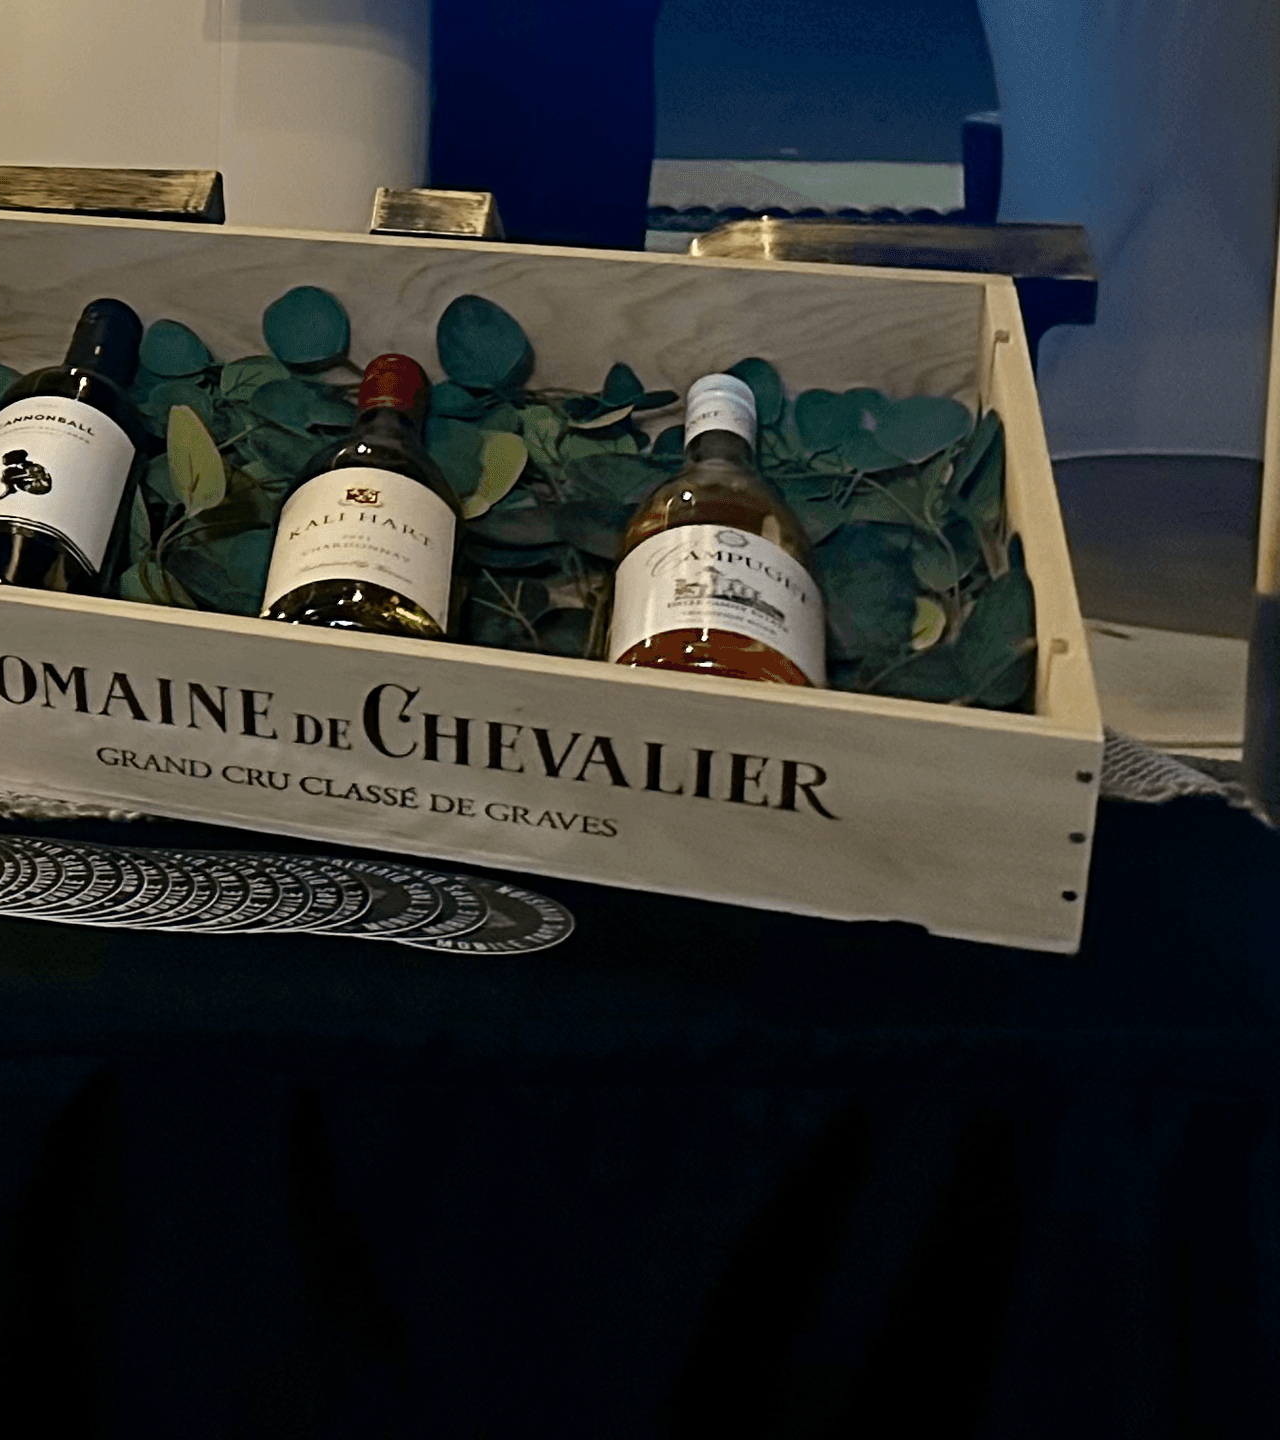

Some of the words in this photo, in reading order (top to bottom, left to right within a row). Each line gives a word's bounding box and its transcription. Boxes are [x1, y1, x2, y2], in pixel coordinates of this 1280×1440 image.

[289, 512, 345, 541] KALI
[359, 512, 436, 548] HART
[96, 745, 211, 781] GRAND
[222, 762, 291, 792] CRU
[299, 772, 420, 812] CLASSÉ
[430, 790, 476, 817] DE
[485, 799, 619, 839] GRAVES
[293, 711, 353, 752] DE
[362, 682, 840, 822] CHEVALIER
